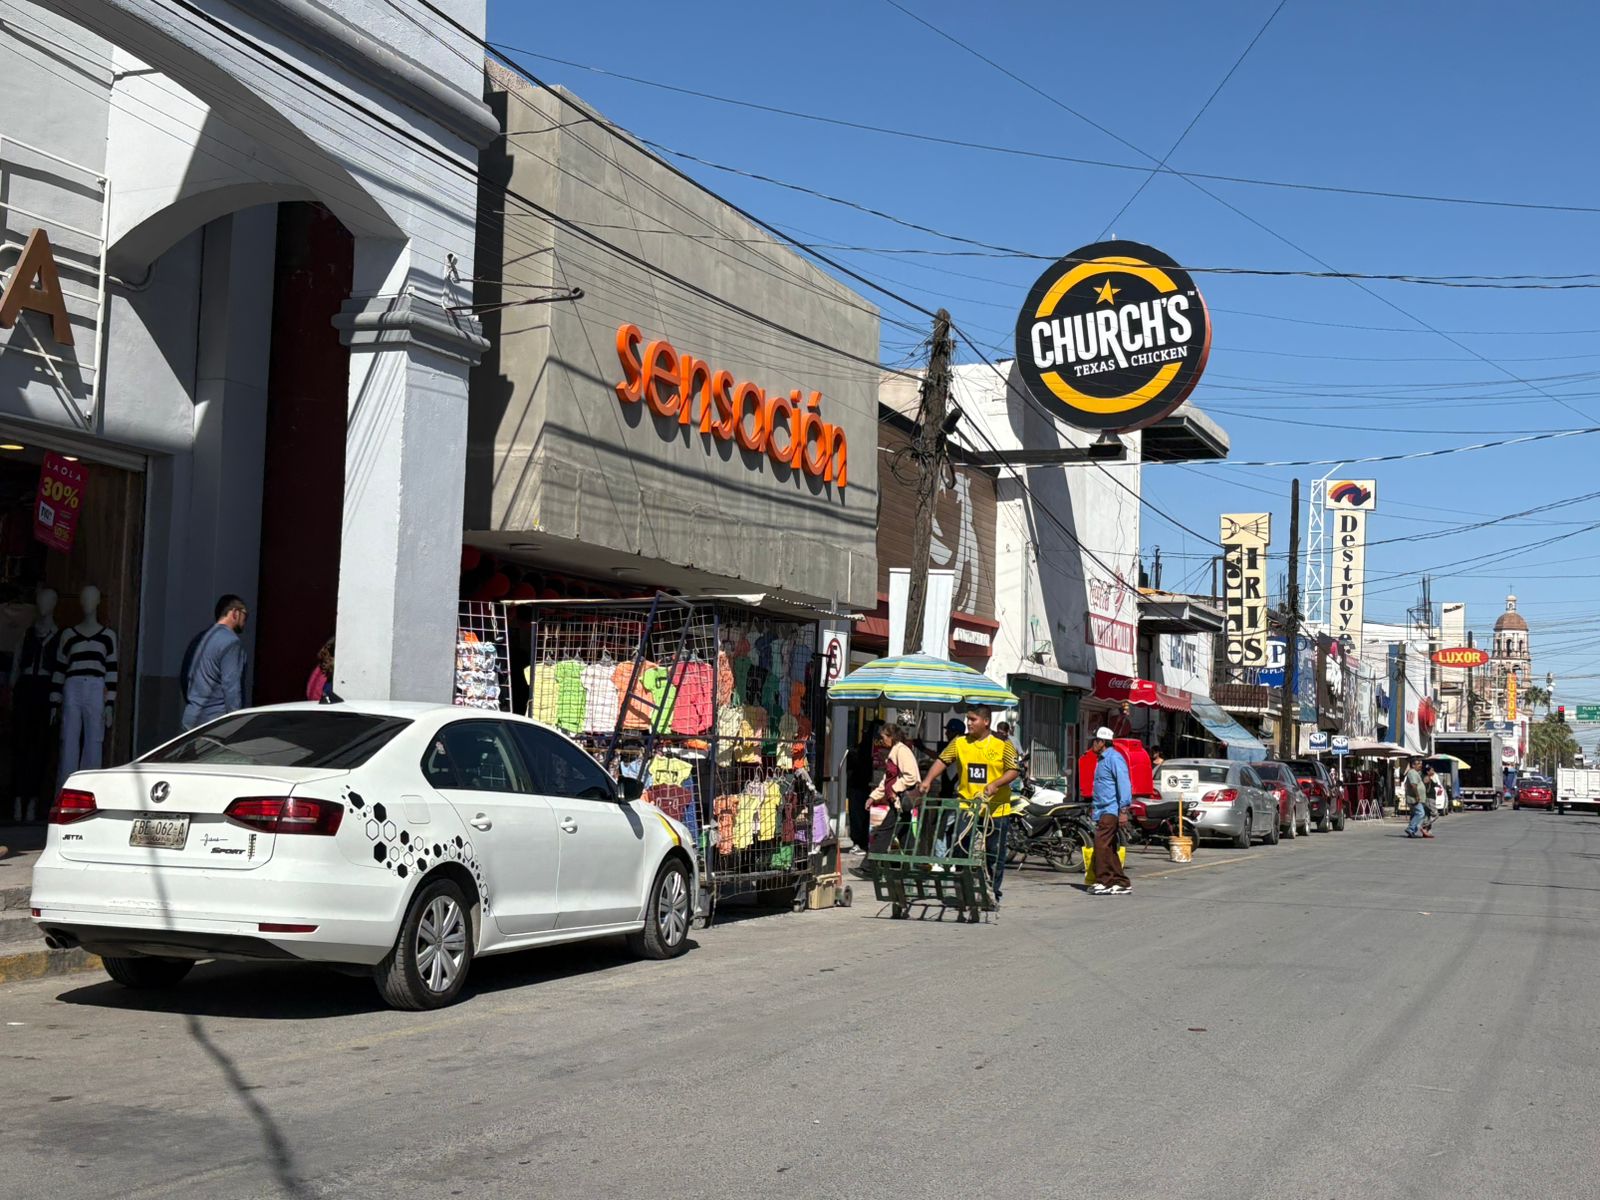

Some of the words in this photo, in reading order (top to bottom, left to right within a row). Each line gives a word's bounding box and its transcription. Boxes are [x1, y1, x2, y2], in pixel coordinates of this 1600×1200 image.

[1031, 294, 1192, 369] CHURCH'S
[1074, 360, 1116, 377] TEXAS
[1130, 346, 1188, 367] CHICKEN
[616, 324, 847, 487] sensación
[41, 476, 79, 508] 30%
[1226, 546, 1243, 664] OPTICA
[1244, 547, 1264, 661] IRIS
[1438, 651, 1482, 663] LUXOR
[1508, 673, 1516, 720] LUXOR
[969, 767, 985, 779] 1&1
